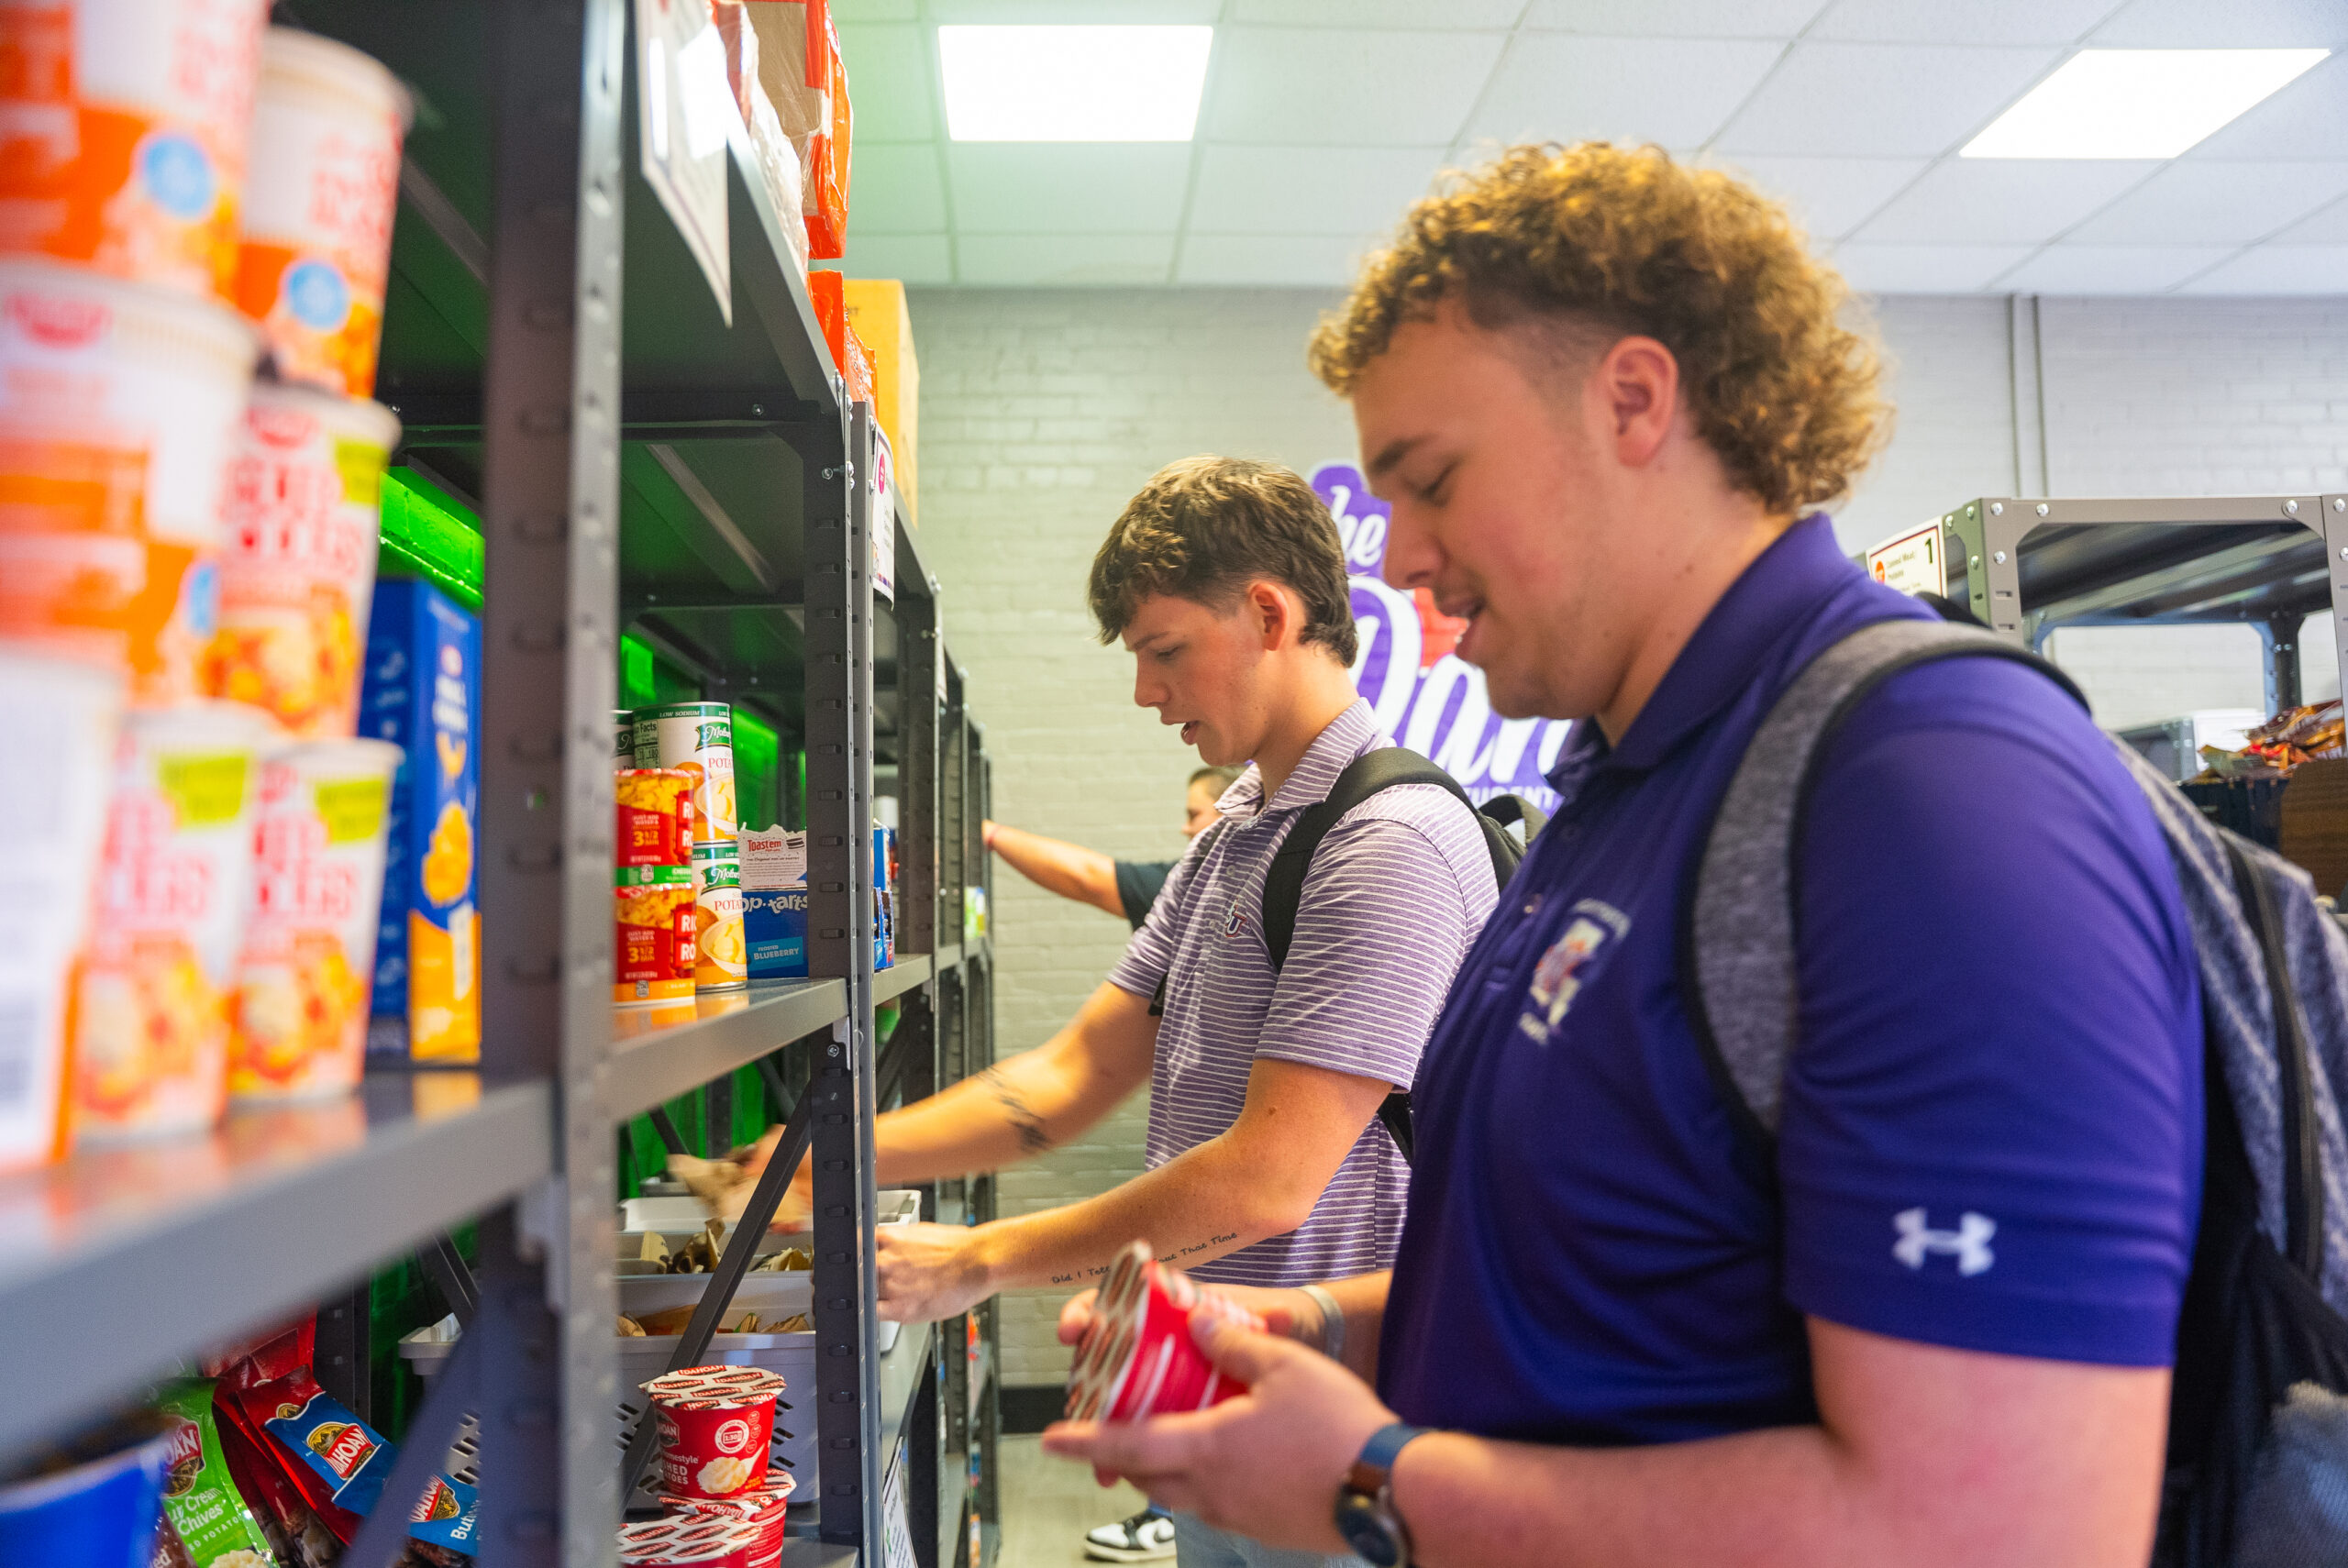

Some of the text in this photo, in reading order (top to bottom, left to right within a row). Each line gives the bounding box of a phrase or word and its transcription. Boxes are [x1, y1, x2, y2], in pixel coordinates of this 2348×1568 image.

[1330, 485, 1387, 567] he
[1924, 537, 1933, 564] 1
[708, 757, 732, 768] POTA
[633, 831, 644, 847] 3
[748, 839, 781, 852] Toastem
[714, 899, 742, 911] POTA
[627, 947, 639, 963] 3
[753, 948, 800, 961] BLUEBERRY
[1210, 1231, 1238, 1245] Time
[680, 1365, 725, 1375] IDAHOAN
[663, 1452, 700, 1464] omestyle
[663, 1461, 688, 1476] HED
[177, 1503, 225, 1536] Chives
[202, 1515, 240, 1542] POTATO
